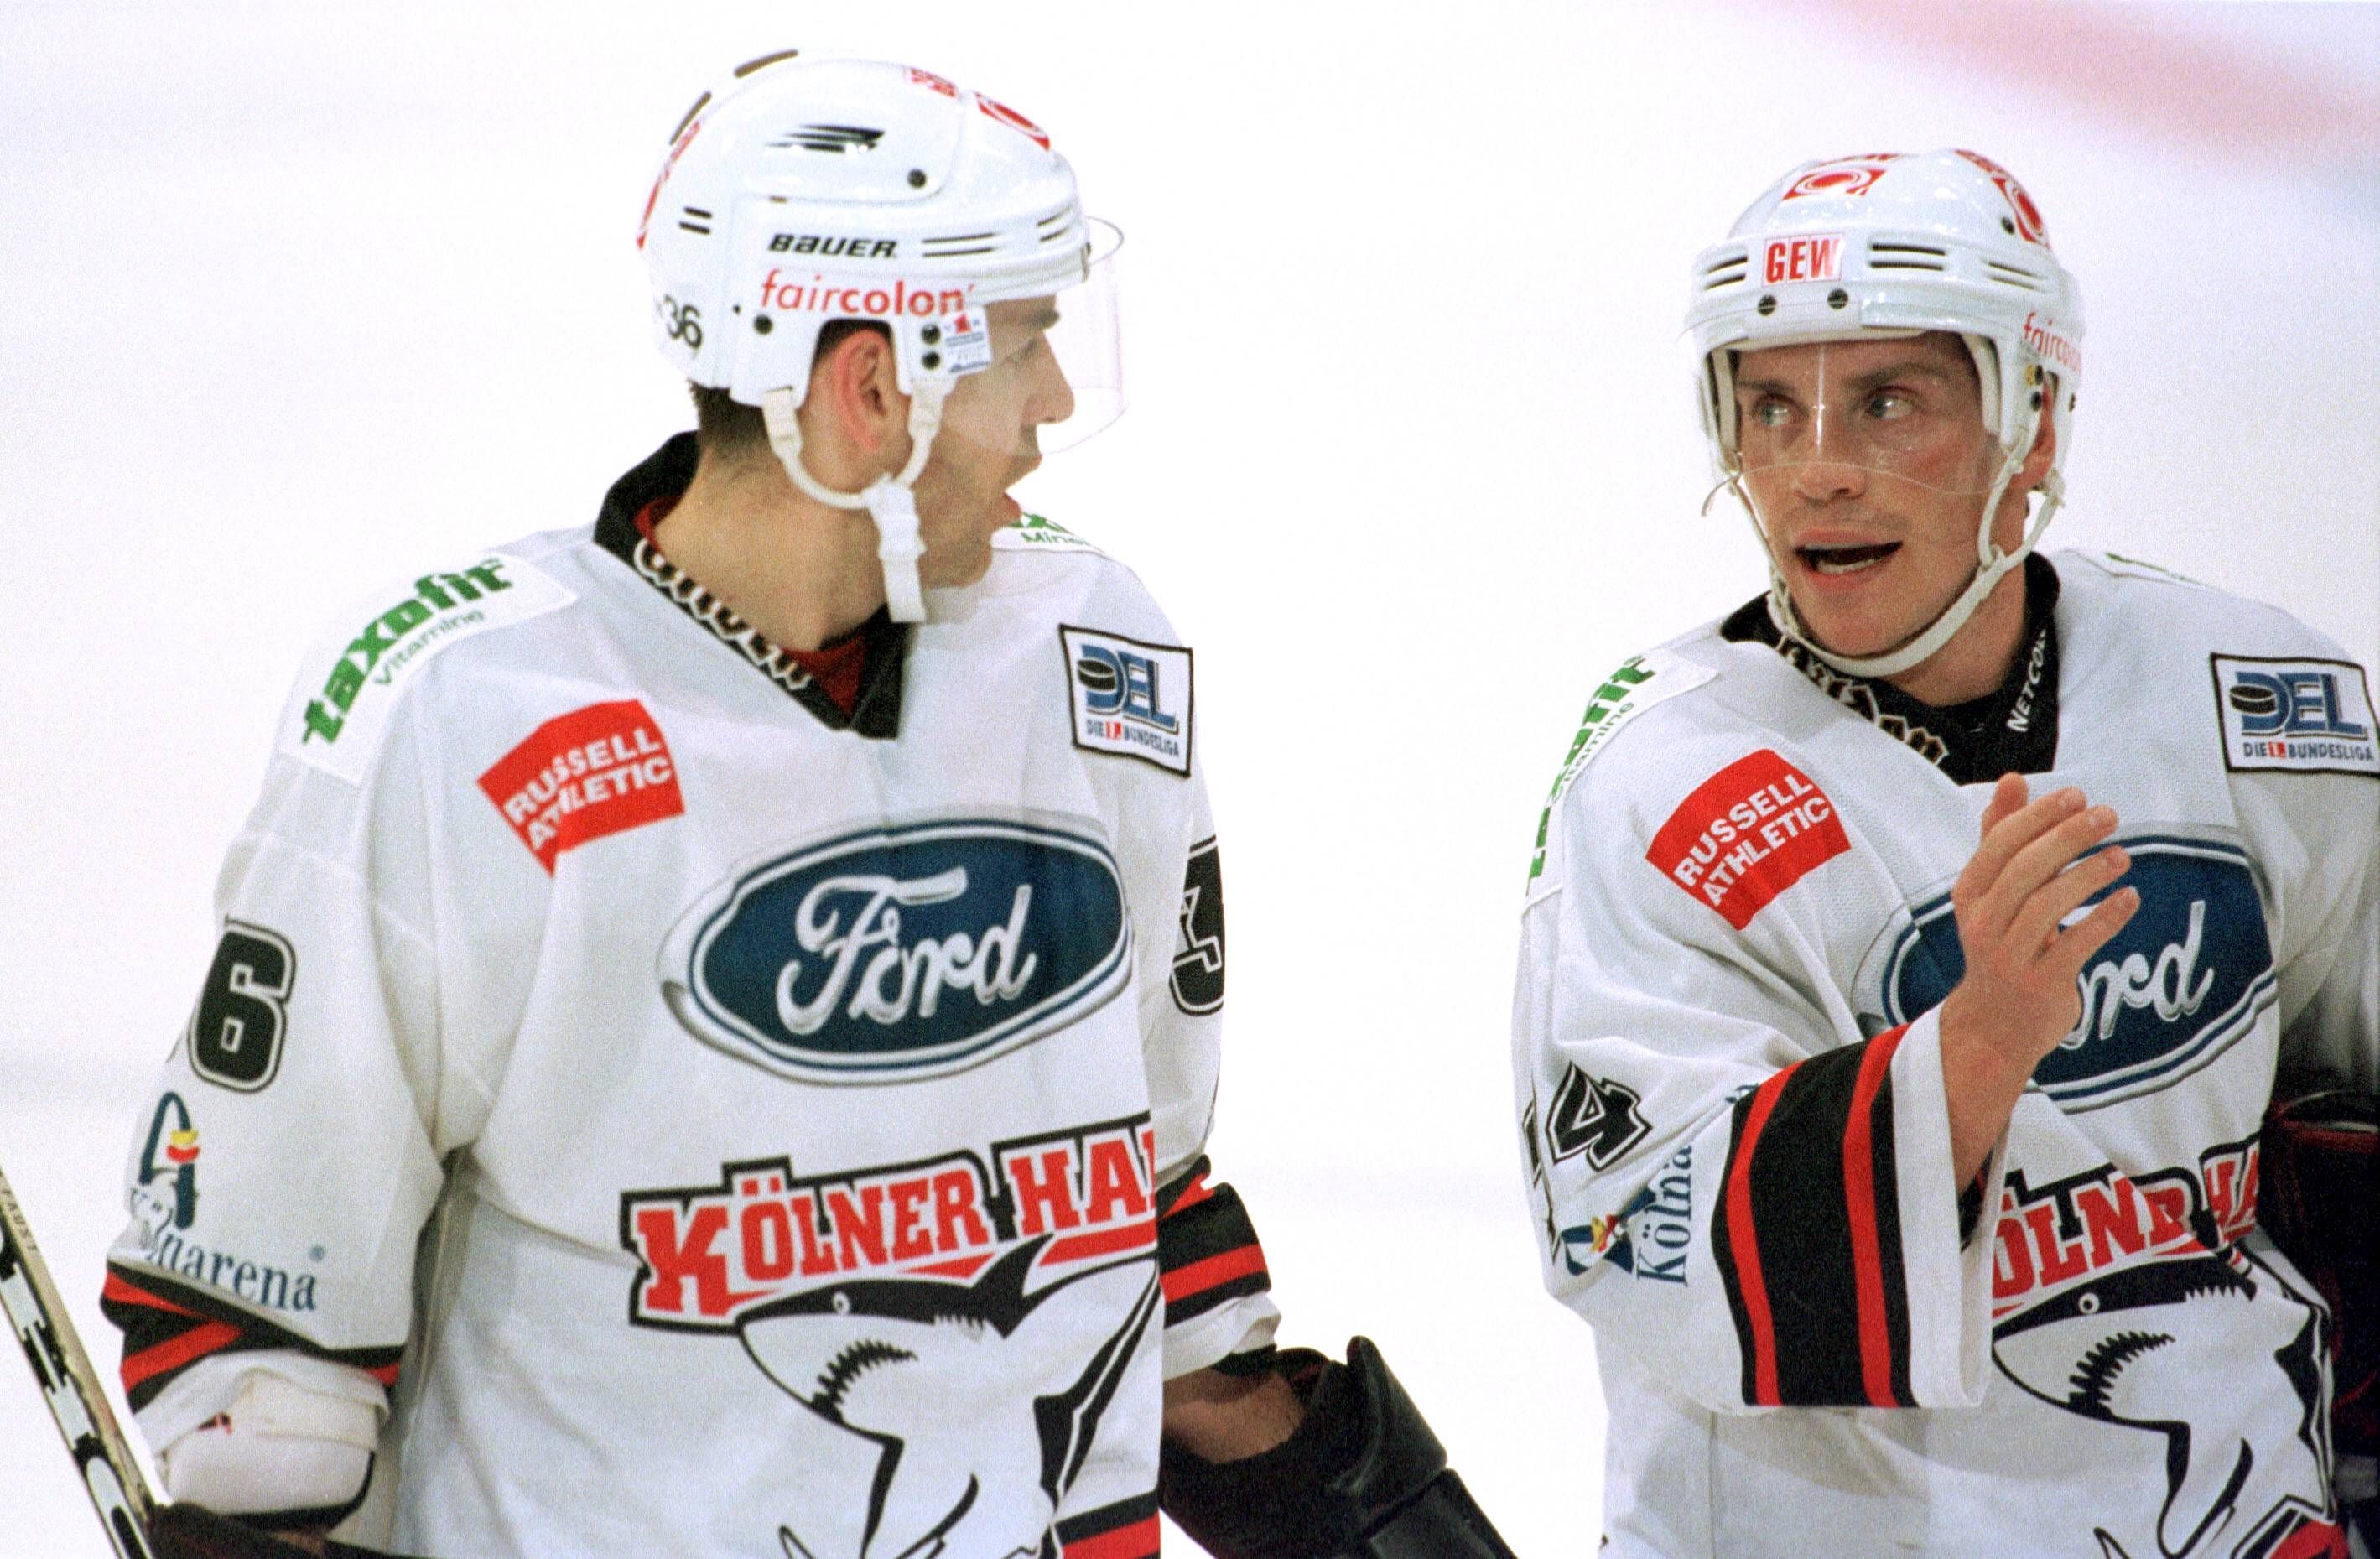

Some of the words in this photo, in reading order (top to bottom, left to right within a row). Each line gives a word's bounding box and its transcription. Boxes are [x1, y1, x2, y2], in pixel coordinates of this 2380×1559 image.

[761, 268, 964, 316] faircolon
[767, 233, 897, 258] BAUER
[1764, 240, 1842, 283] GEW
[302, 559, 513, 745] taxofit
[1077, 643, 1180, 735] DEL
[2228, 671, 2368, 741] DEL
[2242, 742, 2268, 758] DIE
[2288, 742, 2374, 762] BUNDESLIGA
[504, 727, 663, 826] RUSSELL
[1673, 773, 1814, 887] RUSSELL
[1701, 797, 1831, 907] ATHLETIC
[776, 865, 1037, 1036] Ford
[186, 916, 297, 1094] 6
[637, 1167, 990, 1318] KÖLNER
[1008, 1129, 1156, 1237] HA
[1636, 1145, 1693, 1286] Kölna
